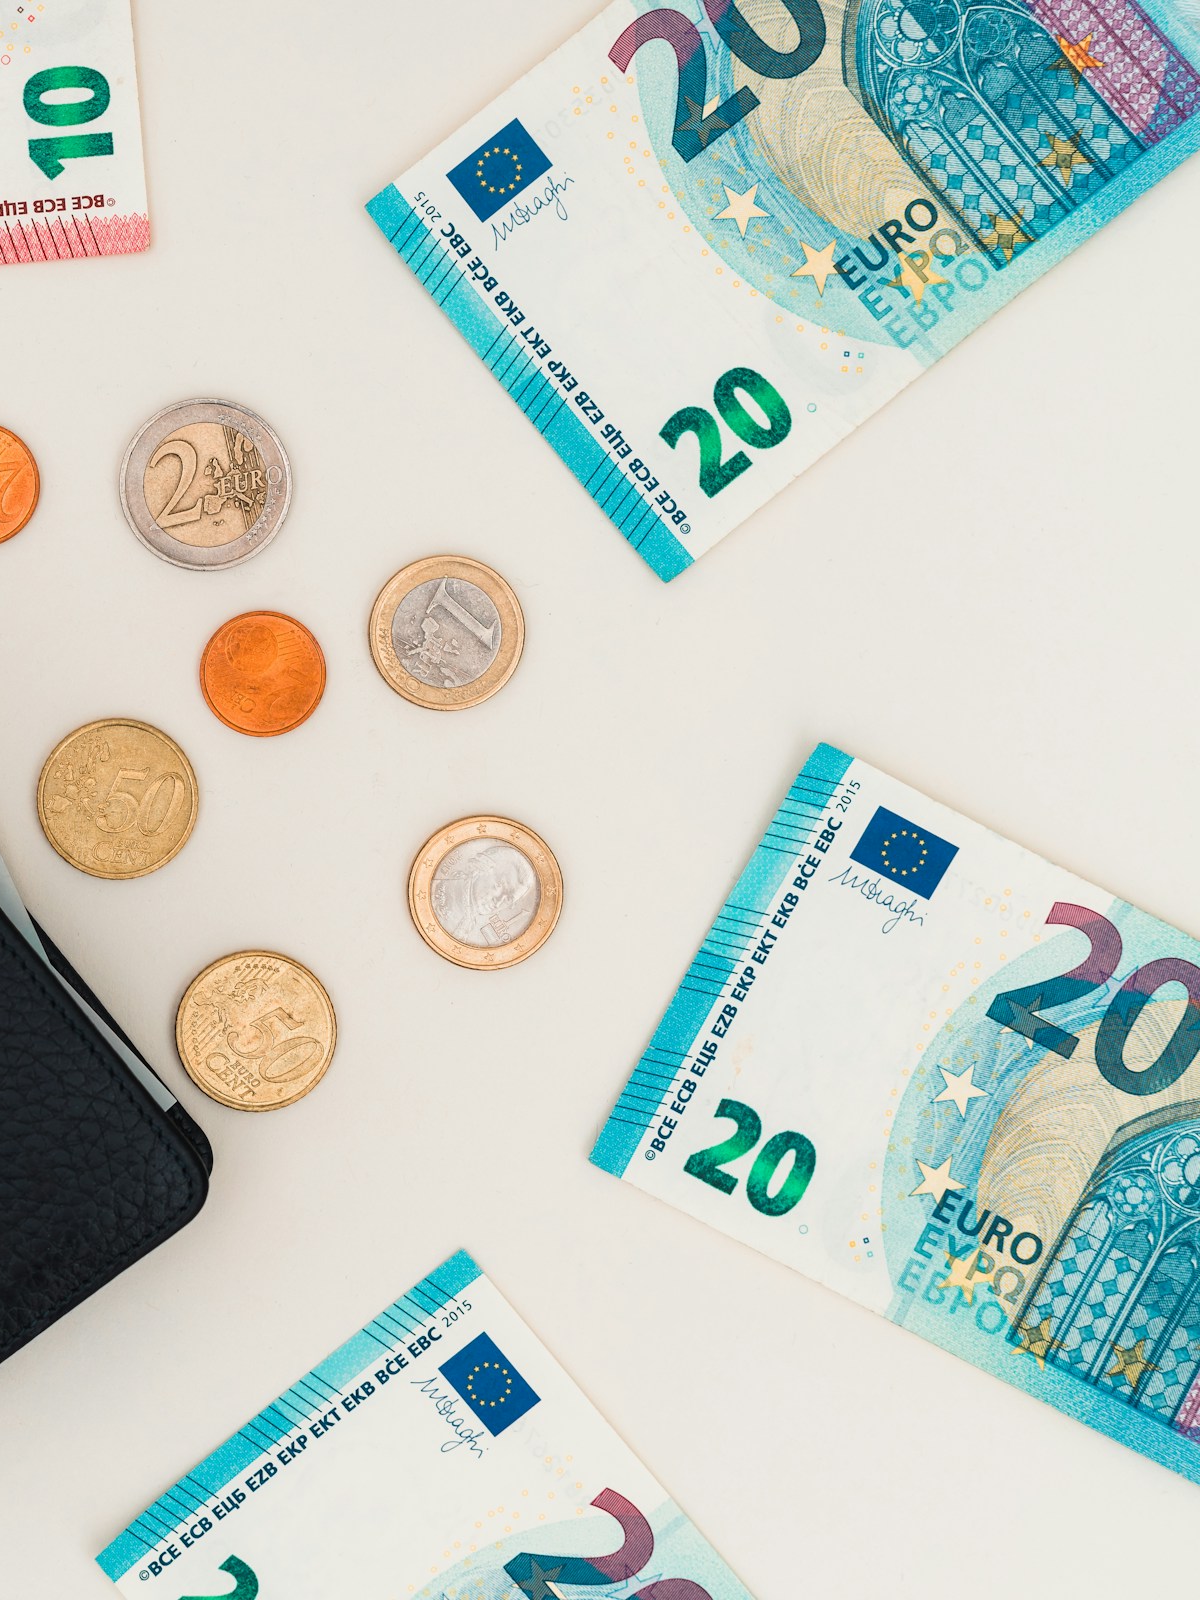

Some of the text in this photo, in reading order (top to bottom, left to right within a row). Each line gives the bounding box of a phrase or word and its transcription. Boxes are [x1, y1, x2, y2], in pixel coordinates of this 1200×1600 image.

[608, 0, 826, 163] 20
[23, 66, 114, 180] 10
[32, 197, 67, 214] ECB
[413, 191, 442, 223] 2015
[440, 222, 473, 259] EBC
[833, 198, 938, 290] EURO
[494, 290, 526, 327] EKB
[547, 360, 579, 393] EKP
[574, 391, 605, 426] EZB
[659, 367, 792, 498] 20
[150, 439, 202, 530] 2
[219, 465, 283, 498] EURO
[628, 457, 660, 493] ECB
[426, 576, 499, 651] 1
[95, 767, 186, 837] 50
[92, 841, 152, 866] CENT
[669, 1078, 698, 1115] ECB
[710, 1003, 738, 1039] EZB
[730, 965, 757, 1003] EKP
[770, 892, 800, 929] EKB
[813, 816, 843, 854] EBC
[835, 779, 861, 813] 2015
[986, 902, 1200, 1096] 20
[204, 1052, 256, 1100] CENT
[227, 1006, 324, 1083] 50
[230, 1061, 261, 1088] EURO
[683, 1098, 817, 1217] 20
[932, 1188, 1043, 1265] EURO
[178, 1516, 213, 1549] ECB
[244, 1461, 278, 1493] EZB
[276, 1434, 308, 1466] EKP
[340, 1380, 376, 1413] EKB
[406, 1326, 443, 1359] EBC
[441, 1299, 472, 1328] 2015
[503, 1487, 715, 1600] 2
